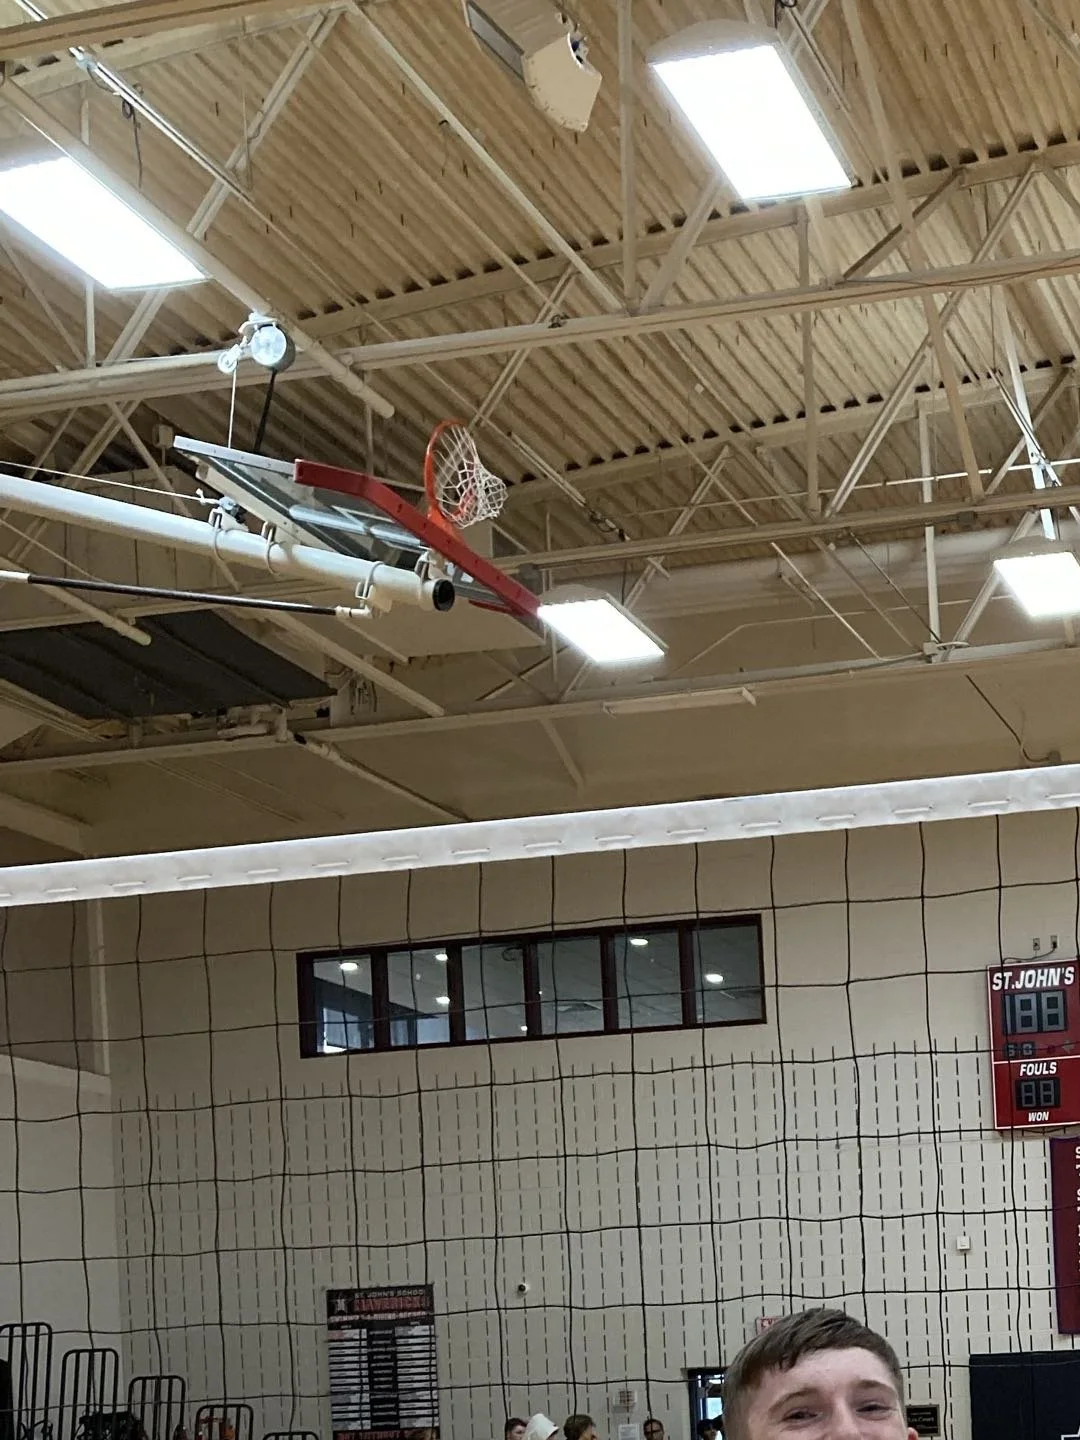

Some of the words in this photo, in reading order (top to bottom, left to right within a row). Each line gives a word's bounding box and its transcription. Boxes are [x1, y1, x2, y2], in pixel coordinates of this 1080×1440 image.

[991, 966, 1076, 991] ST.JOHN'S
[1019, 1061, 1058, 1077] FOULS
[1028, 1111, 1050, 1122] WON
